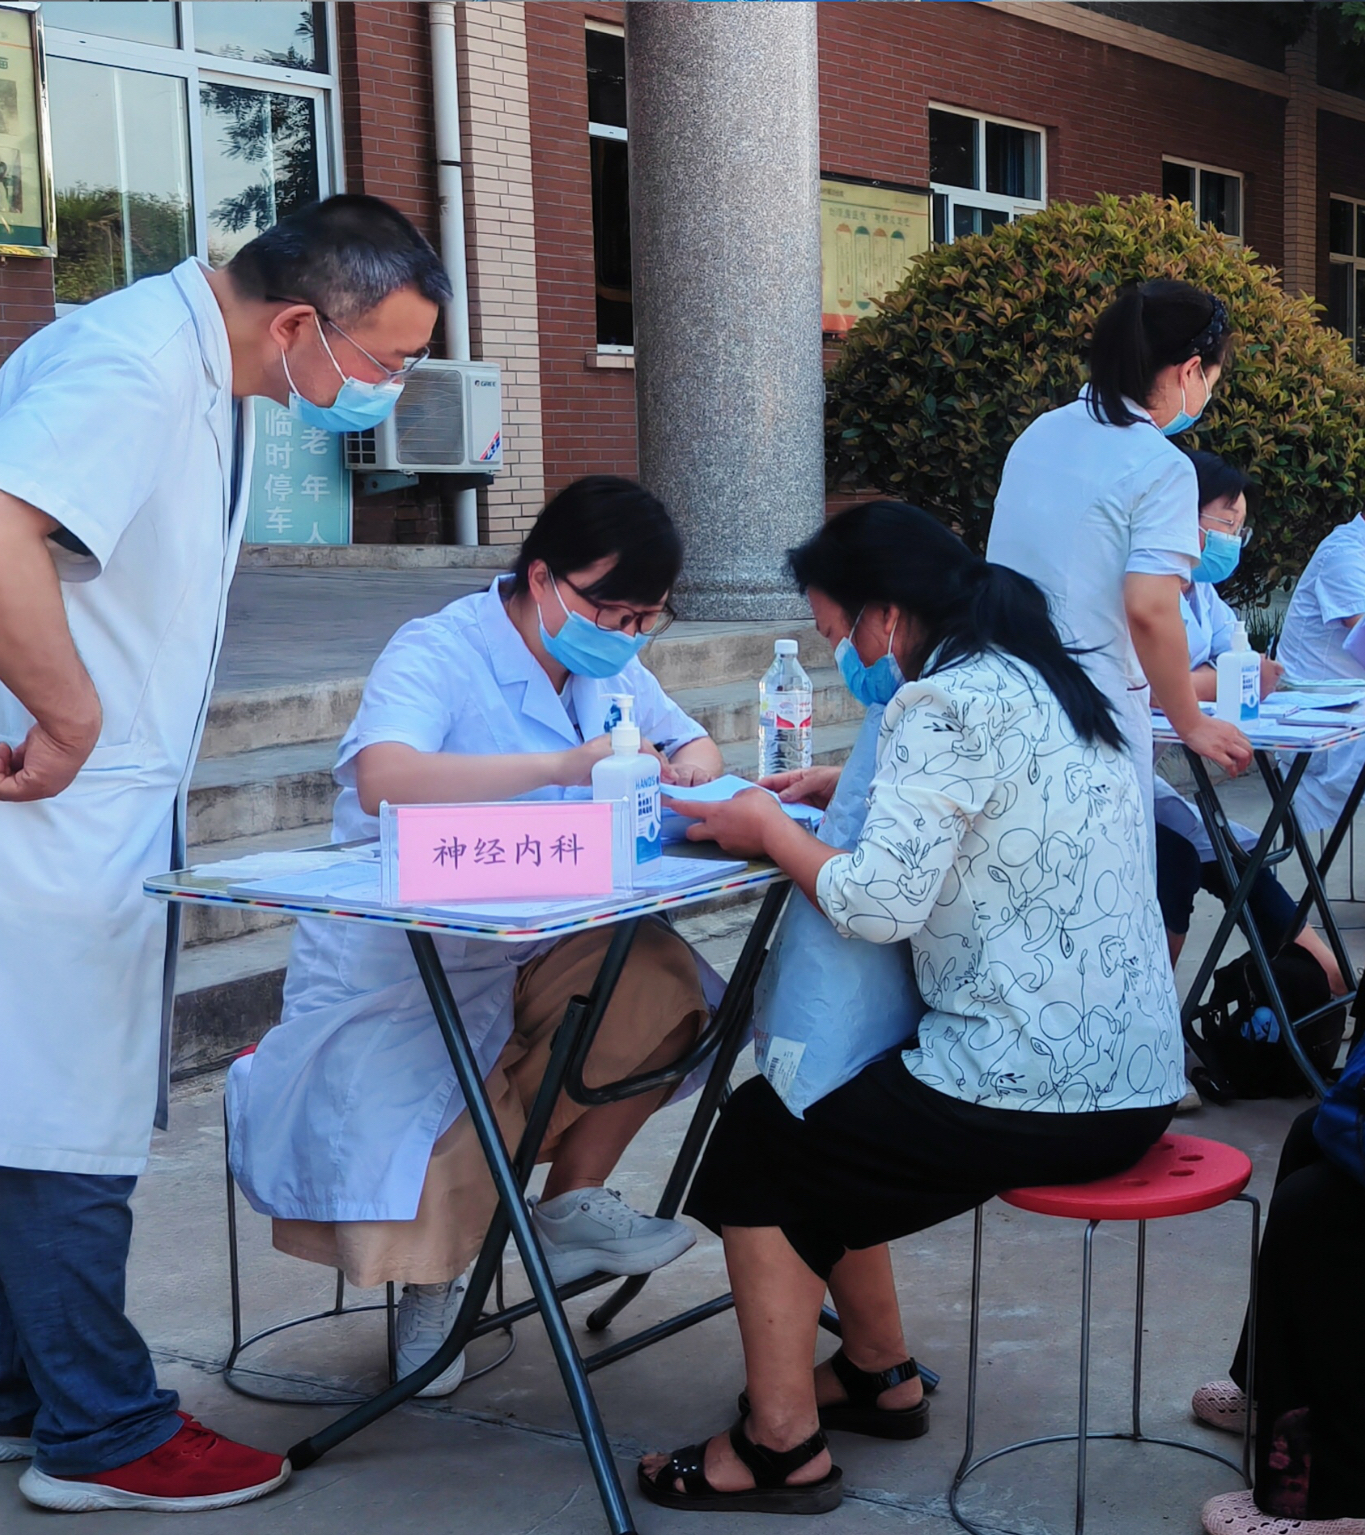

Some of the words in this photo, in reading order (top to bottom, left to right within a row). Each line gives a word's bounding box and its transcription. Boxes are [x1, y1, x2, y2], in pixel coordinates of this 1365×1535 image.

[264, 408, 294, 543] 临时停车
[432, 833, 586, 872] 神经内科
